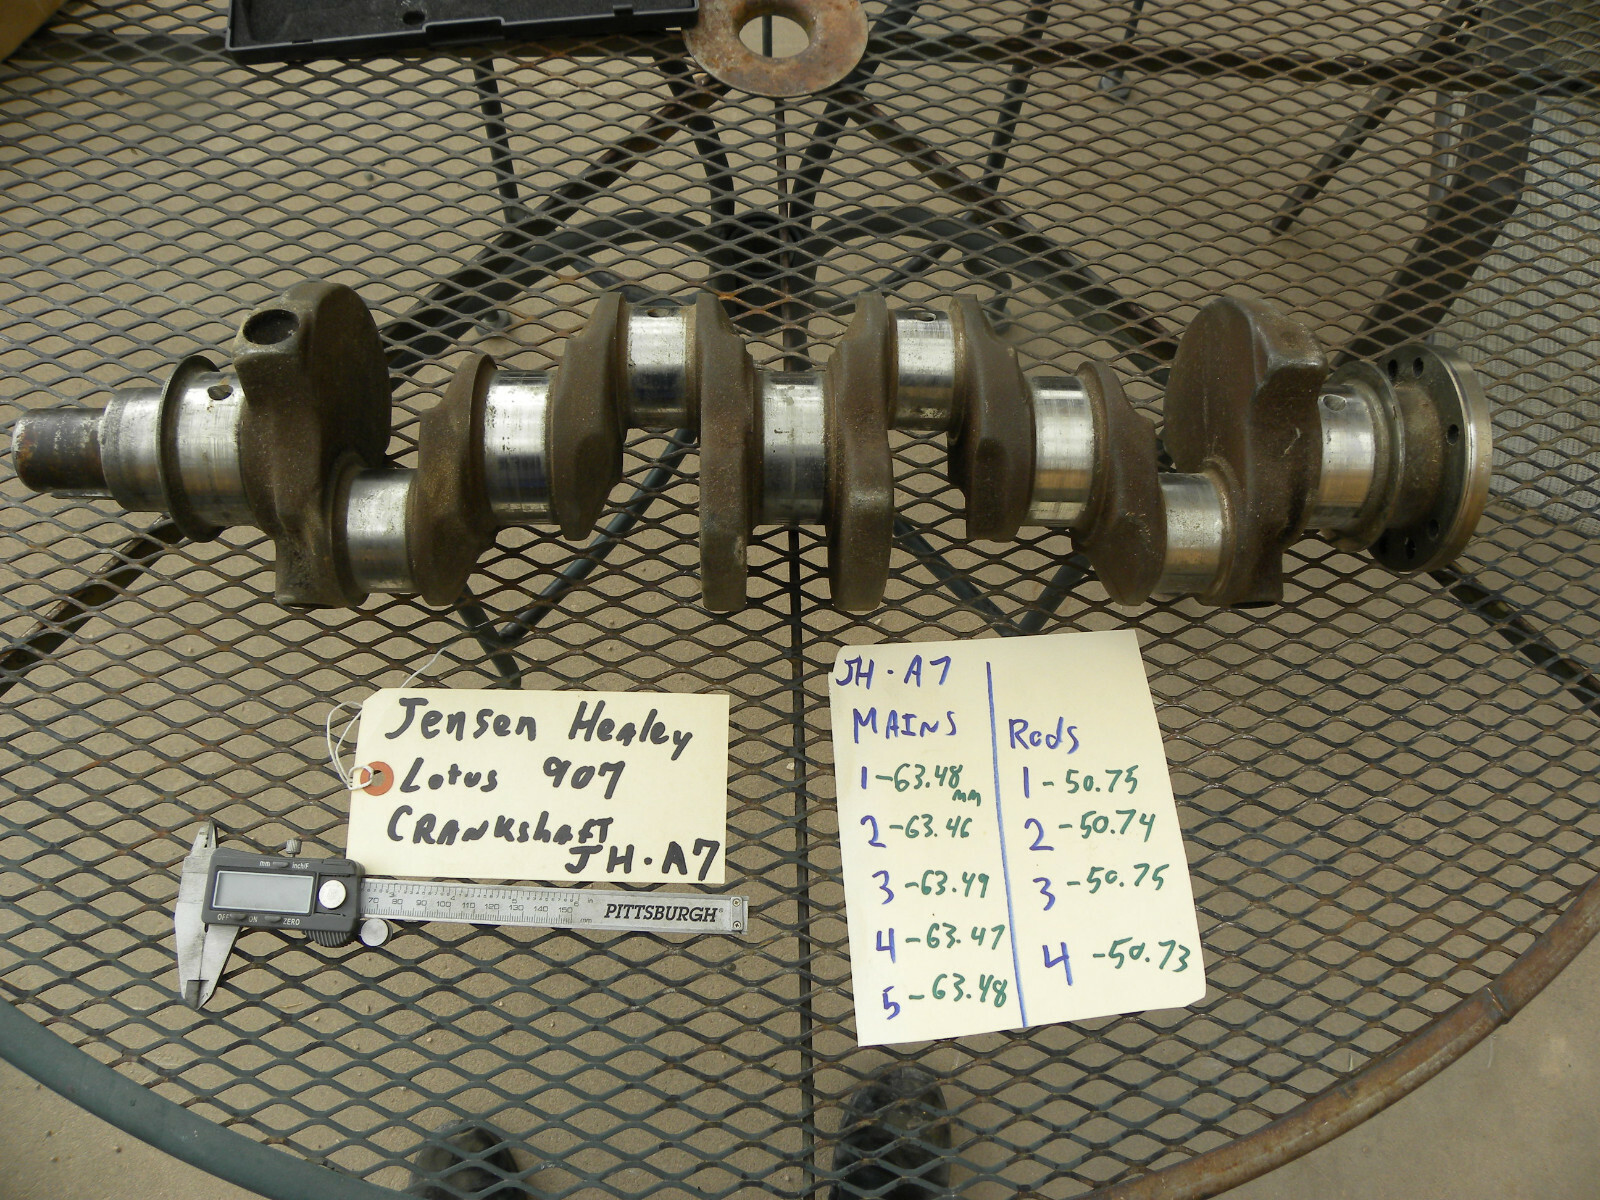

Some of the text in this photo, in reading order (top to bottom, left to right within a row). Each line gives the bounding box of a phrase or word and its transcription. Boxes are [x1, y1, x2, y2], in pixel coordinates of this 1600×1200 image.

[385, 698, 537, 741] Jensen
[1009, 717, 1080, 754] Rods
[400, 756, 625, 799] Lotus 907
[436, 900, 452, 908] 100
[558, 906, 573, 914] 150
[604, 903, 718, 923] PITTSBURGH
[282, 917, 300, 926] ZERO
